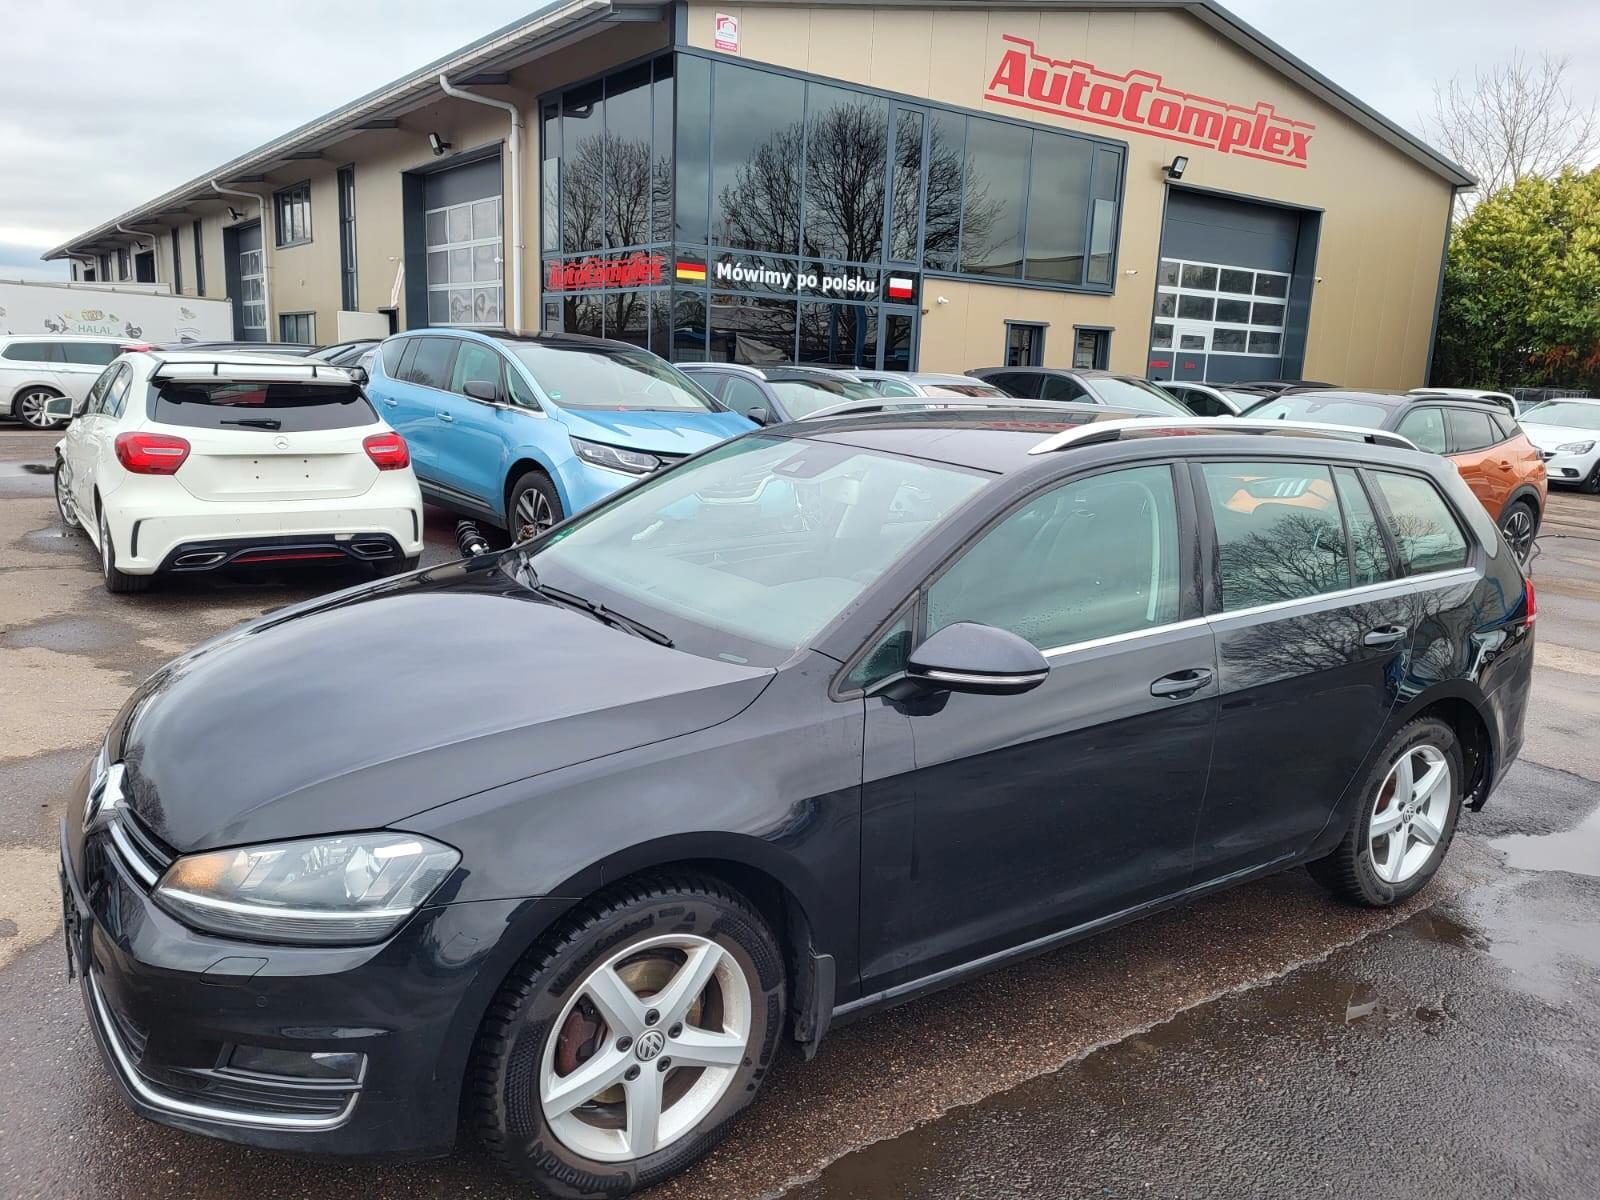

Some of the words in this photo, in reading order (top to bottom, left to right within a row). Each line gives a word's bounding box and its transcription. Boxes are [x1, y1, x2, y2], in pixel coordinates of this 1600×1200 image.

[988, 49, 1313, 161] AutoComplex
[717, 262, 791, 289] Mówimy
[797, 273, 818, 291] po
[822, 273, 875, 293] polsku
[78, 324, 112, 335] HALAL
